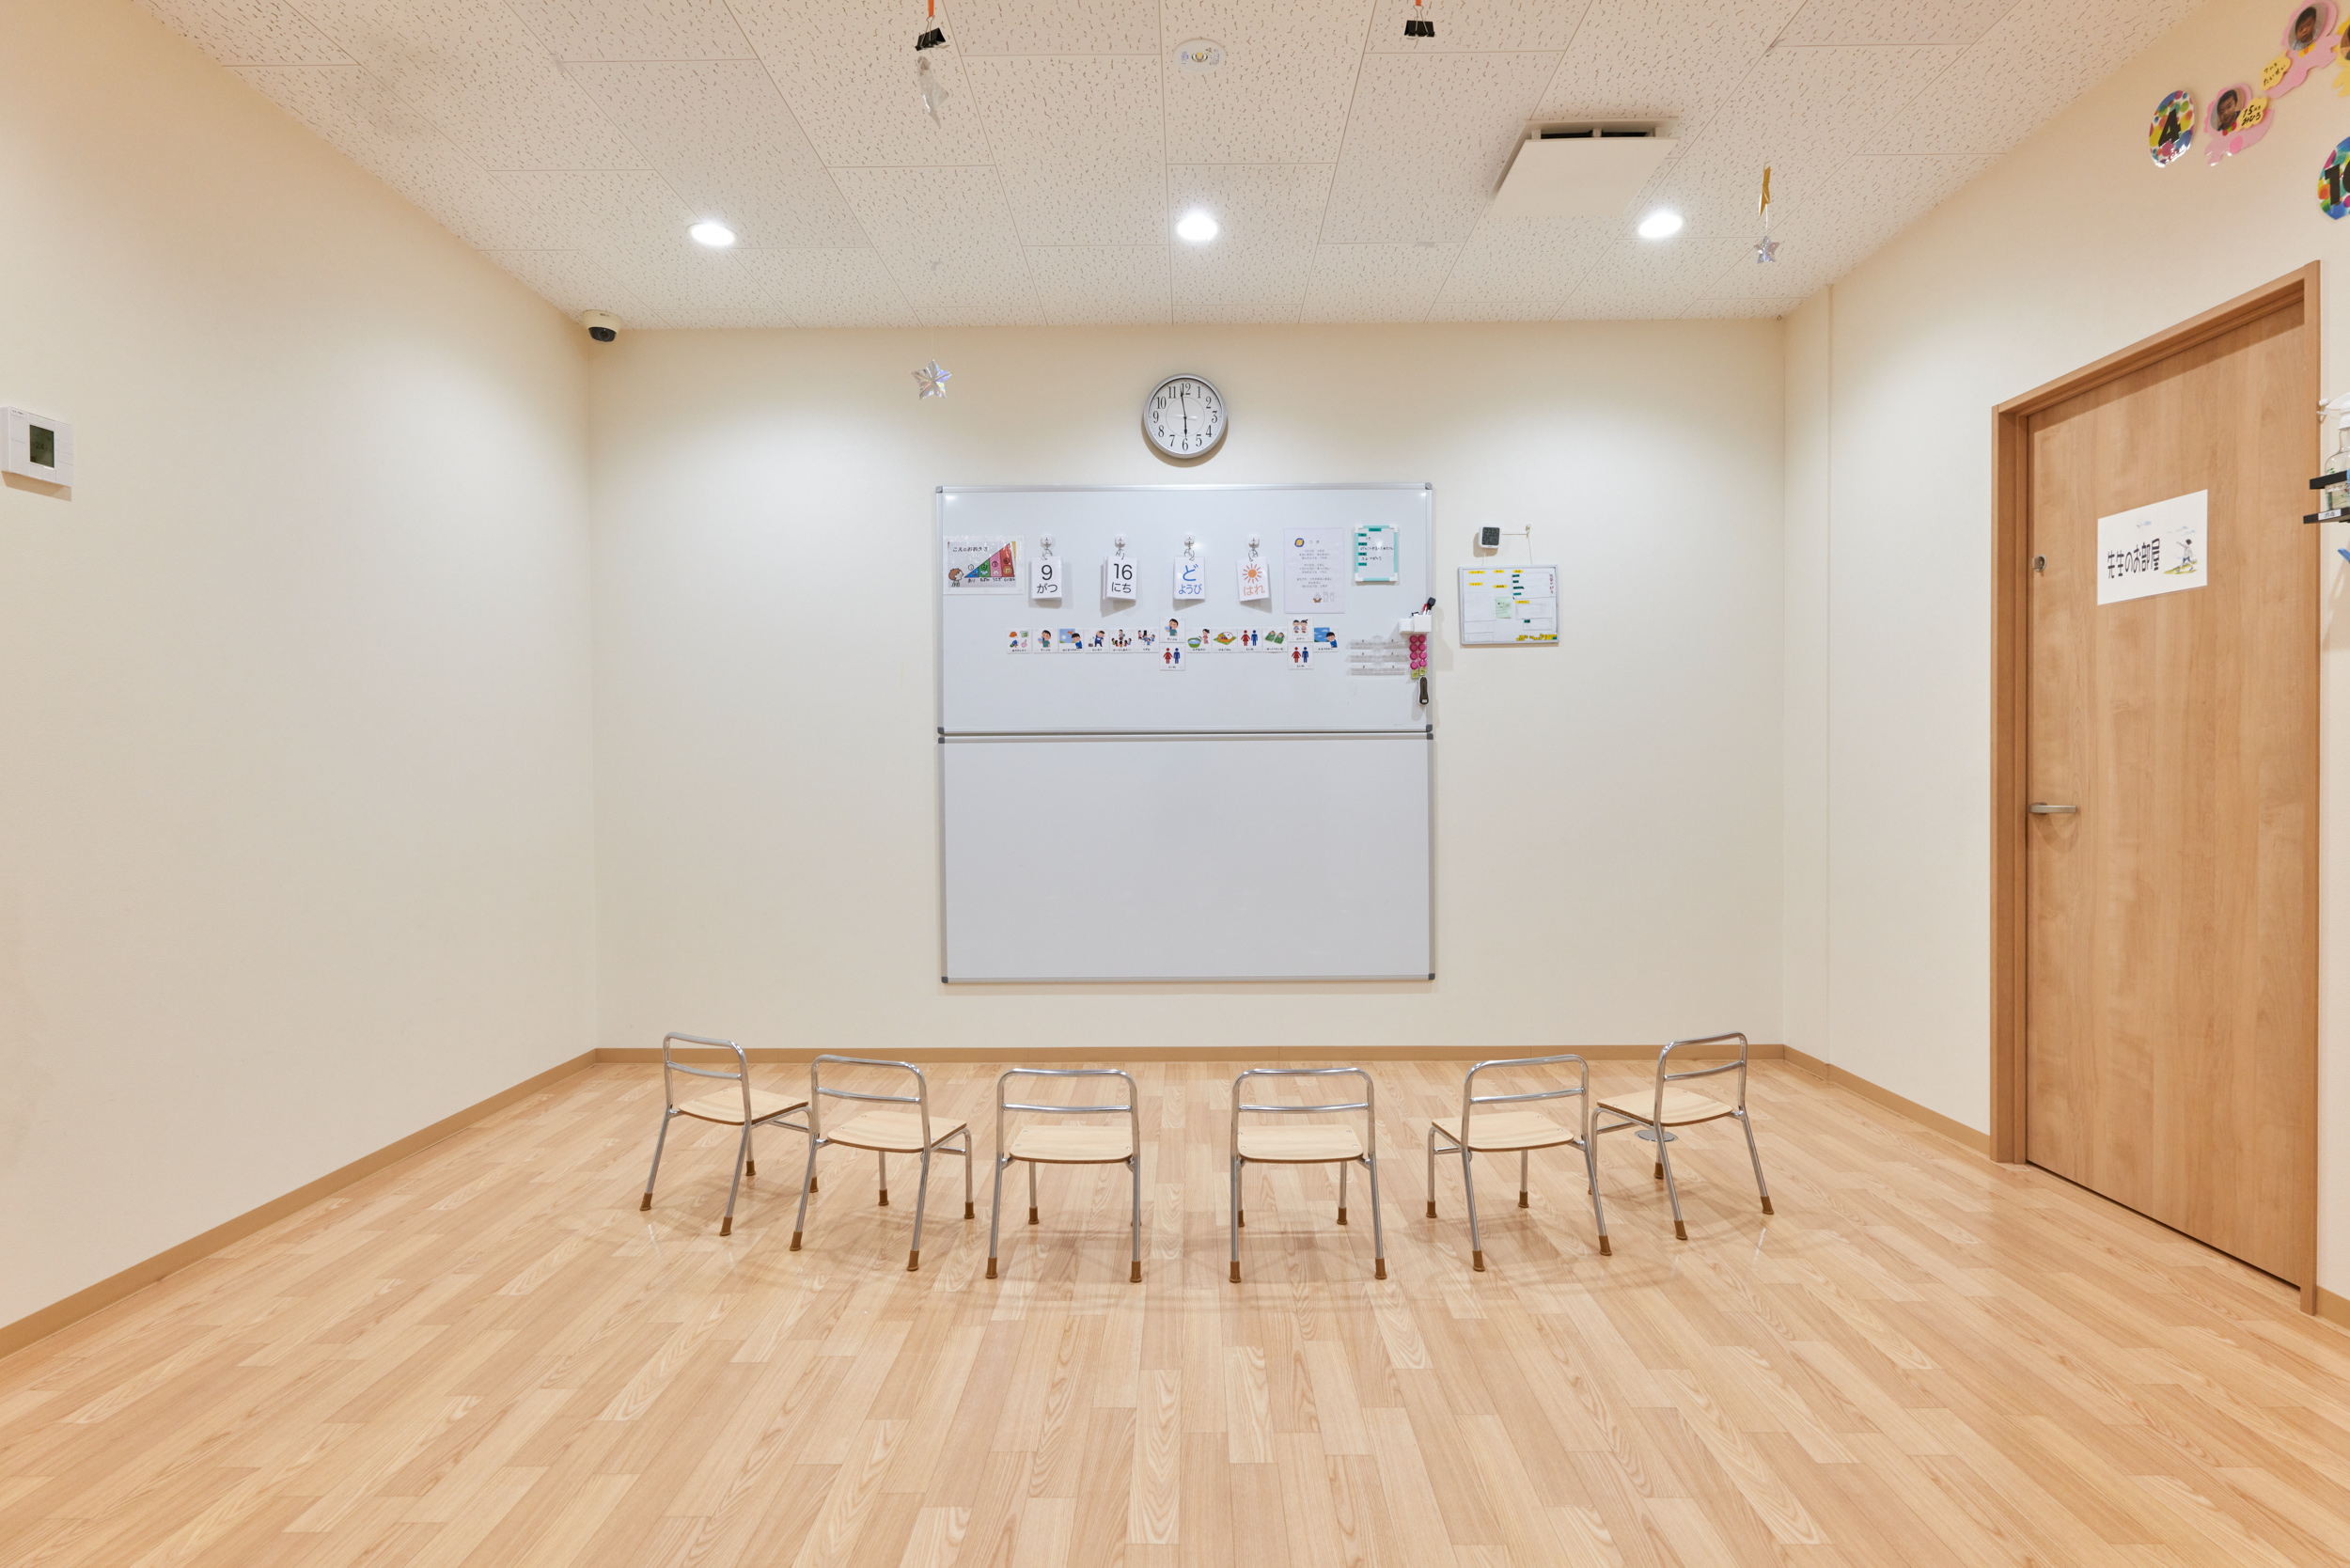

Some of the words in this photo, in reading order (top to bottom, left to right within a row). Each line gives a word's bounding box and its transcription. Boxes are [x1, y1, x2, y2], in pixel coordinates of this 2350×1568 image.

[2158, 108, 2182, 148] 4
[1168, 386, 1176, 399] 11
[1181, 383, 1191, 395] 12
[1197, 386, 1201, 398] 1
[1157, 397, 1167, 409] 10
[1206, 397, 1211, 409] 2
[1153, 411, 1159, 423] 9
[1212, 411, 1217, 423] 3
[1158, 425, 1164, 437] 8
[1206, 425, 1212, 437] 4
[35, 441, 44, 450] 24
[1169, 434, 1175, 447] 7
[1182, 438, 1188, 451] 6
[1196, 434, 1201, 447] 5
[2107, 538, 2160, 579] 先生のお部屋
[1042, 564, 1053, 581] 9
[1114, 563, 1133, 580] 16
[1183, 564, 1198, 582] ど
[1037, 583, 1058, 594] がつ
[1111, 582, 1132, 594] にち
[1178, 584, 1202, 595] ようび
[1243, 585, 1265, 596] はれ
